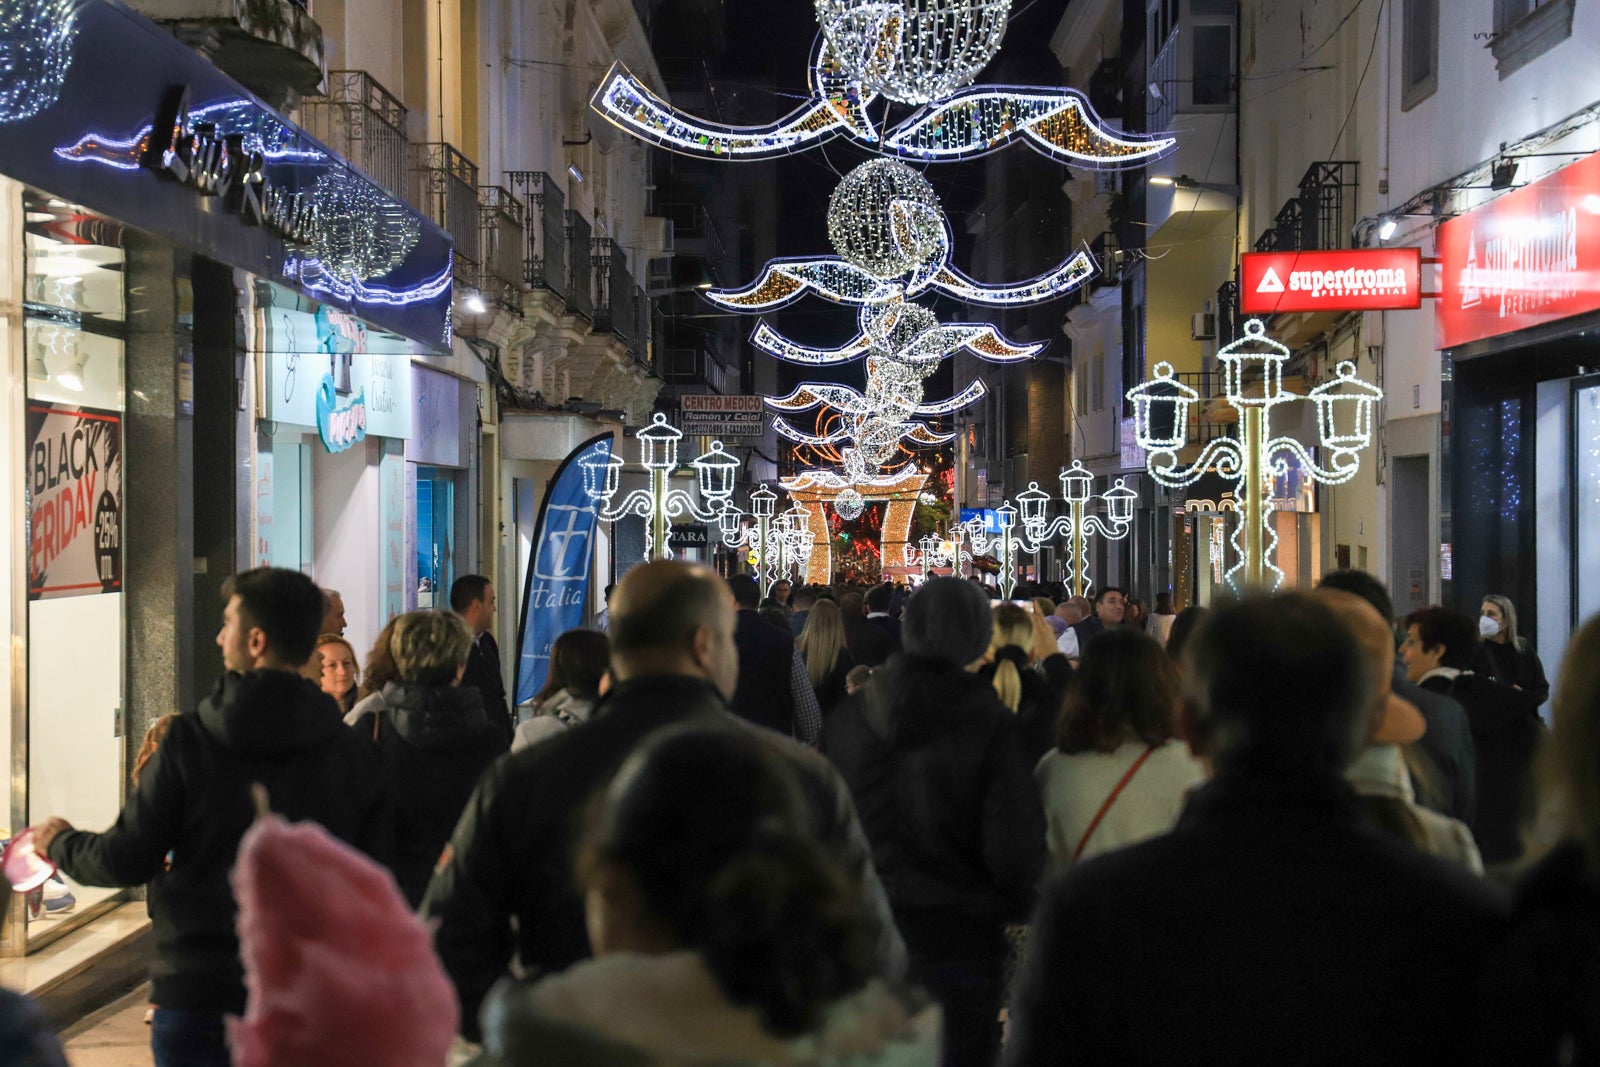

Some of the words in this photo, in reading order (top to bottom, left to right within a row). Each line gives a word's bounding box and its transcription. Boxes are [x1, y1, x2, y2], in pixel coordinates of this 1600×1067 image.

[1289, 267, 1407, 298] superdroma
[1321, 287, 1407, 297] PERFUMERIAS
[684, 396, 722, 410] CENTRO
[724, 396, 761, 411] MEDICO
[725, 414, 732, 422] y
[734, 412, 761, 422] Cajal
[683, 424, 723, 434] CONDUCTORES
[729, 425, 761, 434] CAZADORES
[34, 425, 100, 496] BLACK
[31, 470, 98, 582] FRIDAY
[96, 511, 119, 549] -25%
[671, 531, 707, 542] TARA
[531, 581, 582, 608] talia
